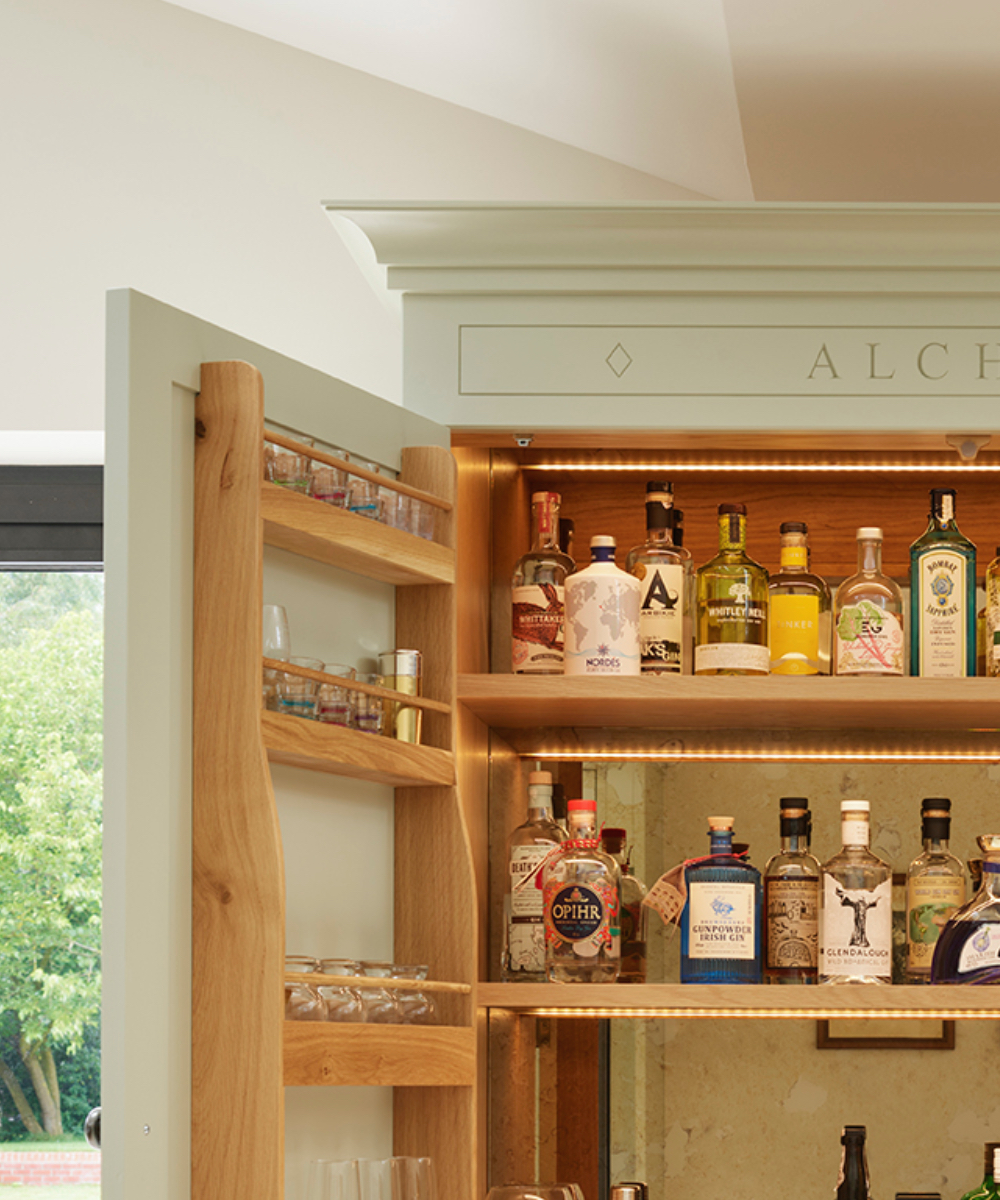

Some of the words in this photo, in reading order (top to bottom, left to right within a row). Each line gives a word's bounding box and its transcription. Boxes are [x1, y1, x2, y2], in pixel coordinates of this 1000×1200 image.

[926, 560, 957, 574] BOMBAY
[709, 606, 746, 617] WHITLEY
[925, 603, 959, 616] SAPPHIRE
[552, 904, 602, 920] OPIHR
[692, 924, 753, 934] GUNPOWDER
